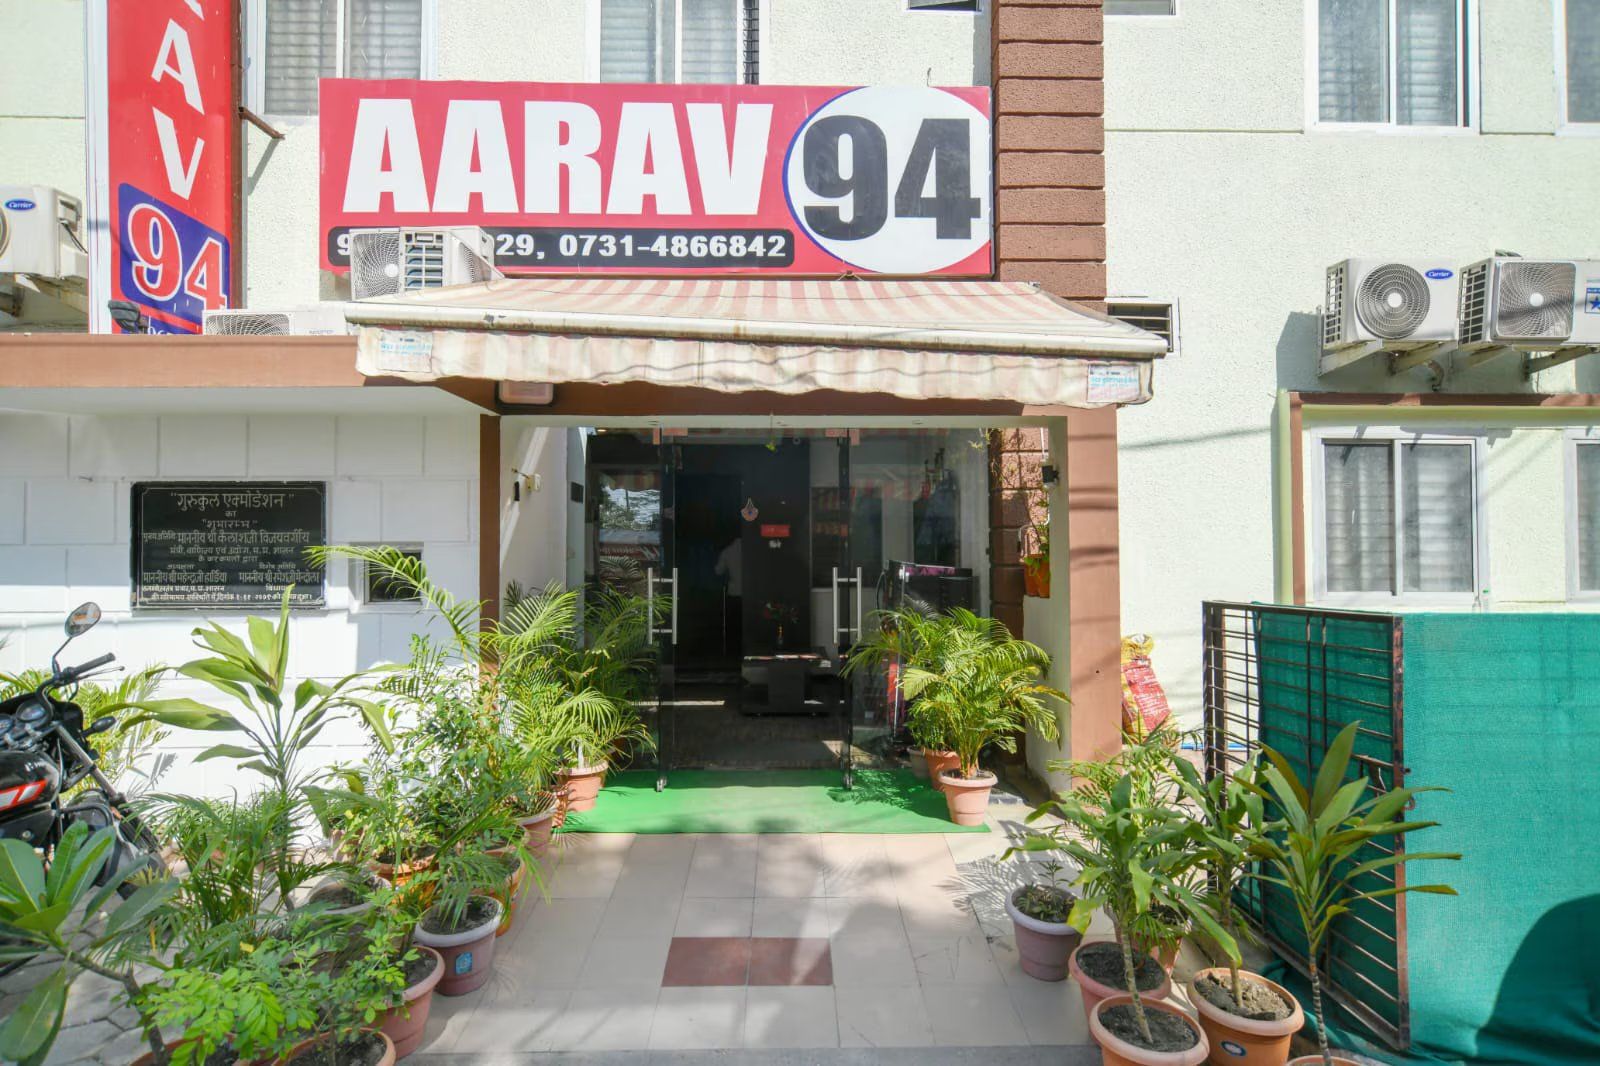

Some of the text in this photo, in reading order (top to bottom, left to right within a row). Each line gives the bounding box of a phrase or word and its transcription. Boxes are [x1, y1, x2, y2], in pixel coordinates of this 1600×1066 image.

[342, 98, 982, 241] AARAV 94
[8, 200, 34, 209] Carrier
[127, 202, 228, 309] 94
[558, 233, 787, 258] 0731-4866842
[1426, 270, 1451, 278] Carrier
[177, 529, 206, 544] माननीय
[207, 528, 216, 544] श्री
